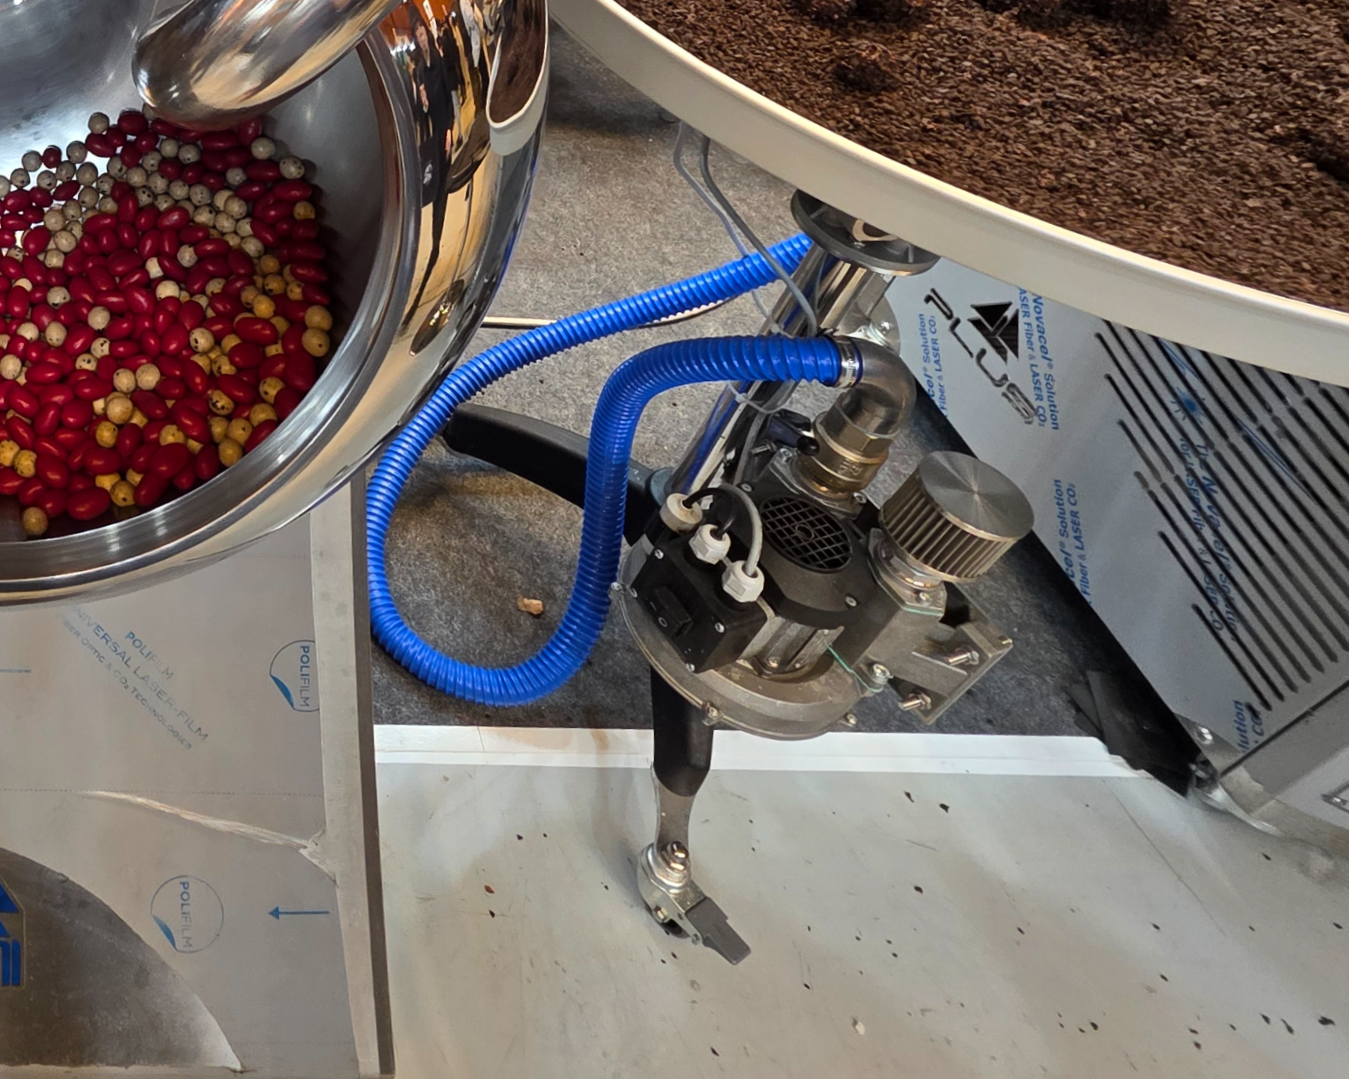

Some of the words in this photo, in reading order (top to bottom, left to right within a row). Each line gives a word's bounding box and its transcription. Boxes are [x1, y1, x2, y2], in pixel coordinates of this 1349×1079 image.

[918, 313, 931, 364] Solution
[923, 287, 1038, 425] PLUS
[931, 337, 943, 372] LASER
[1023, 322, 1035, 353] Fiber
[1029, 363, 1044, 402] LASER
[937, 383, 948, 411] Fiber
[1043, 372, 1060, 431] Solution
[1053, 478, 1070, 539] Solution
[1069, 509, 1085, 551] LASER
[1079, 561, 1091, 597] Fiber
[124, 630, 175, 681] POLIFILM
[298, 644, 311, 708] POLIFILM
[80, 636, 106, 664] OPTIC
[130, 685, 193, 751] TECHNOLOGIES
[132, 665, 209, 742] LASER-FILM
[179, 880, 194, 950] POLIFILM
